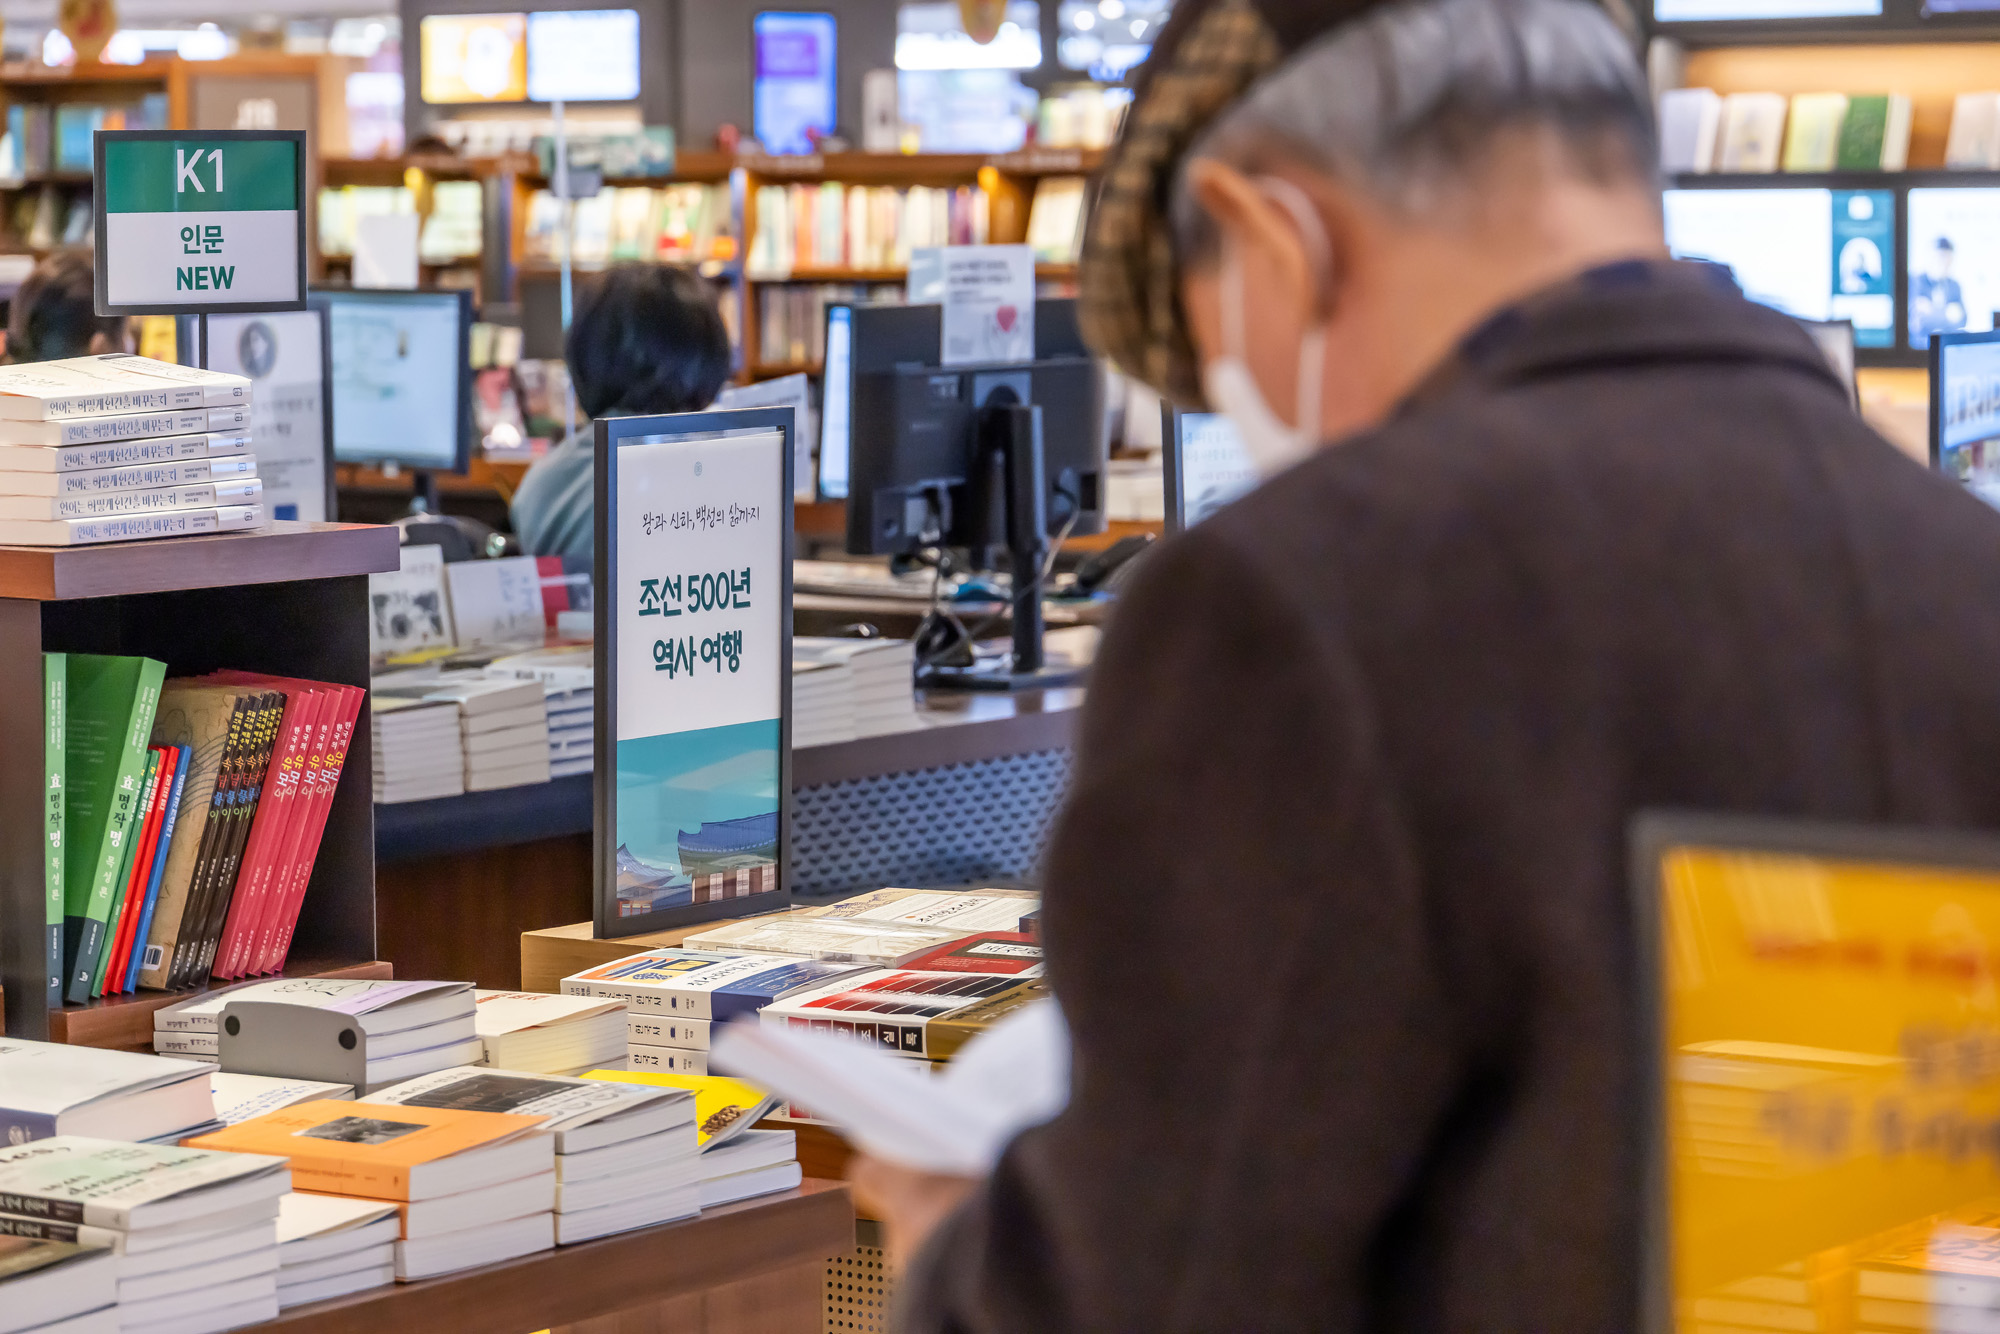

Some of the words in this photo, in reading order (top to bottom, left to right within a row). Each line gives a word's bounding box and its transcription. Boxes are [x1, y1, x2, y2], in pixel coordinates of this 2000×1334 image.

[177, 148, 224, 192] K1
[180, 224, 224, 254] 인문
[176, 266, 235, 290] NEW
[642, 512, 666, 535] 왕과
[728, 502, 760, 528] 삶까지
[638, 575, 682, 617] 조선
[687, 566, 750, 613] 500년
[653, 635, 696, 680] 역사
[700, 630, 742, 673] 여행
[289, 726, 300, 753] 한국의
[300, 724, 312, 751] 한국의
[316, 725, 328, 751] 한국의
[331, 723, 343, 750] 한국의
[339, 722, 352, 748] 한국의
[274, 756, 292, 803] 유모어
[286, 754, 304, 800] 유모어
[301, 755, 320, 800] 유모어
[316, 754, 335, 799] 유모어
[636, 995, 662, 1007] 한국사
[635, 1024, 661, 1036] 한국사
[634, 1054, 659, 1066] 한국사
